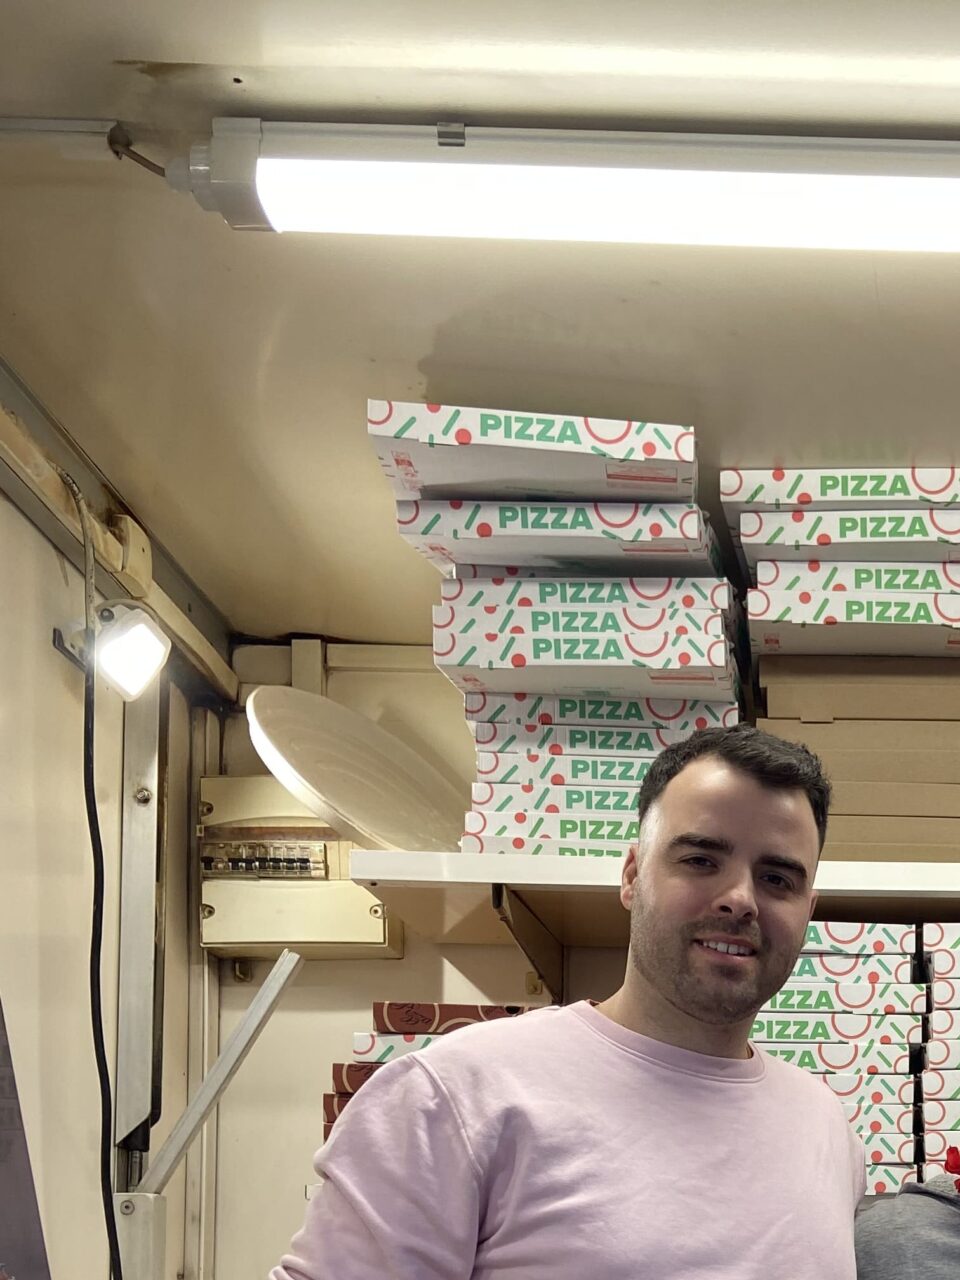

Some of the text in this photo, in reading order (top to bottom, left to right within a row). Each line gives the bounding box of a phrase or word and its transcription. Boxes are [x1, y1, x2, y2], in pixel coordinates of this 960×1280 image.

[480, 413, 582, 445] PIZZA
[819, 474, 910, 497] PIZZA
[499, 506, 594, 529] PIZZA
[838, 515, 928, 538] PIZZA
[854, 567, 943, 590] PIZZA
[539, 582, 628, 604] PIZZA
[531, 610, 621, 633] PIZZA
[844, 599, 934, 624] PIZZA
[532, 637, 624, 661] PIZZA
[560, 700, 641, 719] PIZZA
[570, 730, 653, 751] PIZZA
[560, 819, 640, 841] PIZZA
[770, 989, 834, 1010] IZZA
[750, 1019, 831, 1041] PIZZA
